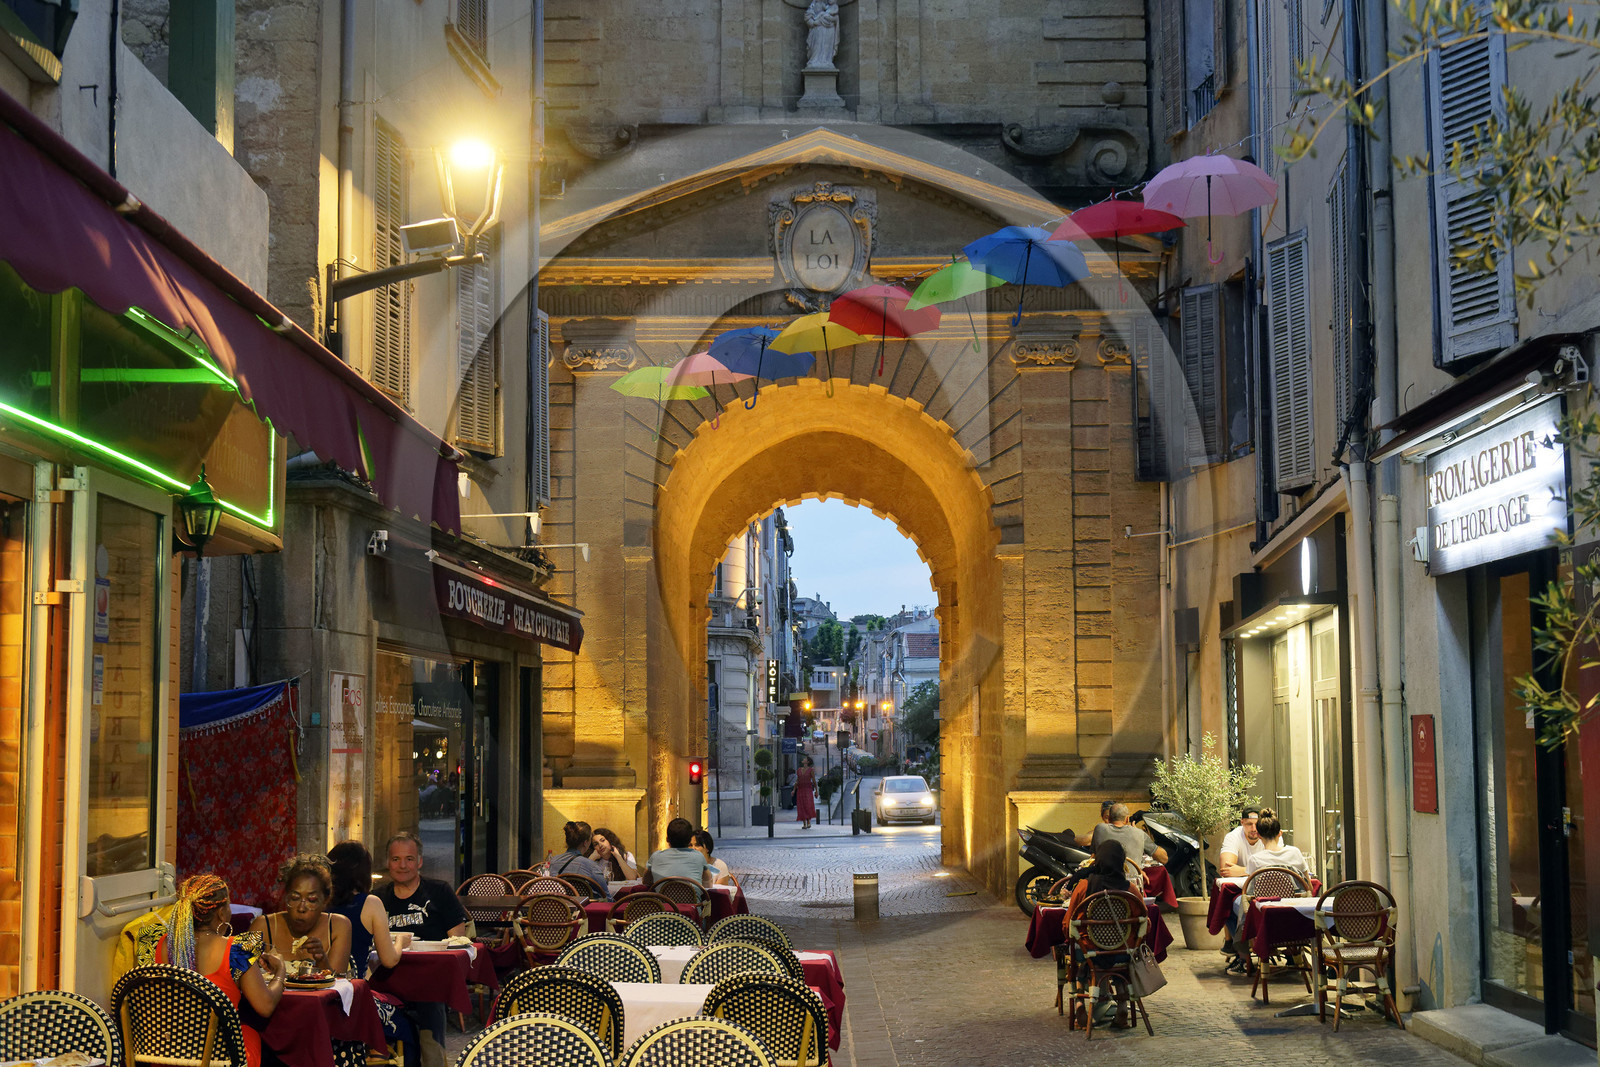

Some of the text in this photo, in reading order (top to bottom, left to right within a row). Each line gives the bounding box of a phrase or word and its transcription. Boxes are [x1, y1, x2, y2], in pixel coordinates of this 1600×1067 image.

[810, 229, 835, 245] LA
[805, 254, 839, 270] LOI
[1425, 430, 1536, 508] FROMAGERIE
[1434, 493, 1531, 550] DE L'HORLOGE
[447, 579, 571, 646] BOUCHERIE CHARCUTERIE
[344, 688, 362, 707] ROS
[769, 659, 777, 704] HÔTEL
[389, 695, 416, 720] Espagnoles
[417, 696, 442, 717] Charcuterie
